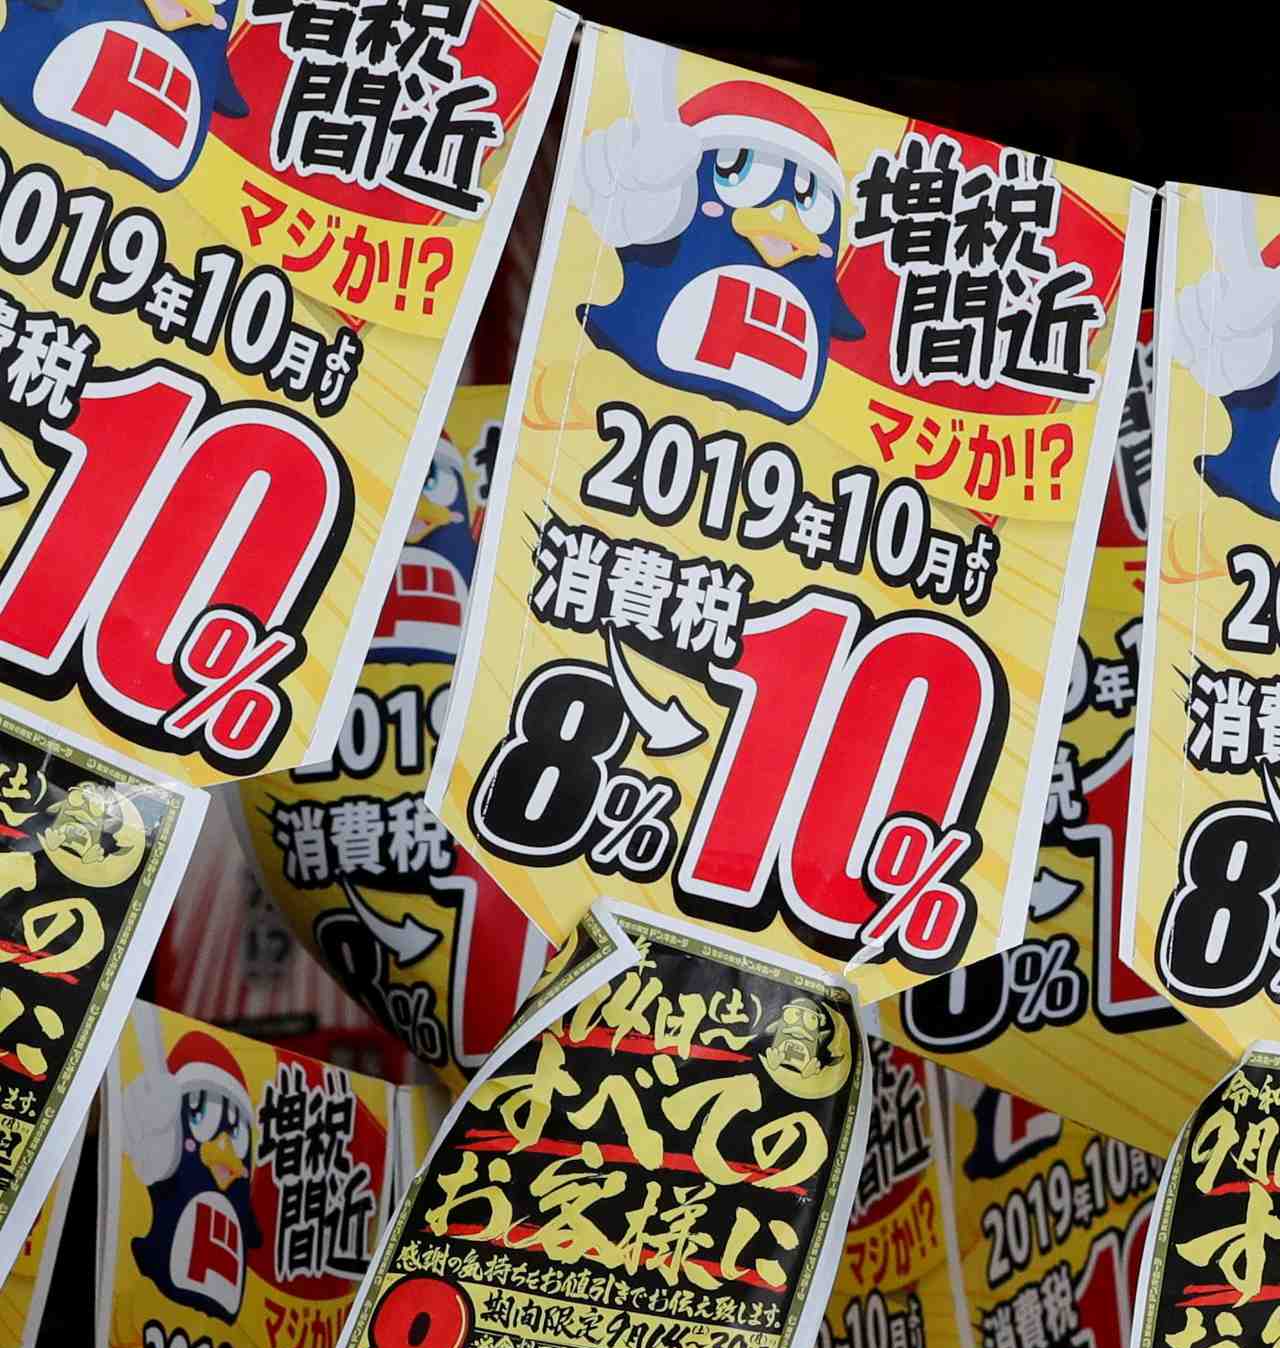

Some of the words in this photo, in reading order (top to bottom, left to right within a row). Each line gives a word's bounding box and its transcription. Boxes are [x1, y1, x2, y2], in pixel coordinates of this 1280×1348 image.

[278, 66, 498, 211] 間近
[899, 272, 1097, 389] 間近
[533, 525, 748, 658] 消費税
[474, 663, 675, 873] 8%
[680, 595, 996, 958] 10%
[273, 800, 456, 882] 消費税
[470, 1035, 829, 1190] すべての
[278, 1168, 374, 1278] 間近
[428, 1143, 797, 1296] お客様に
